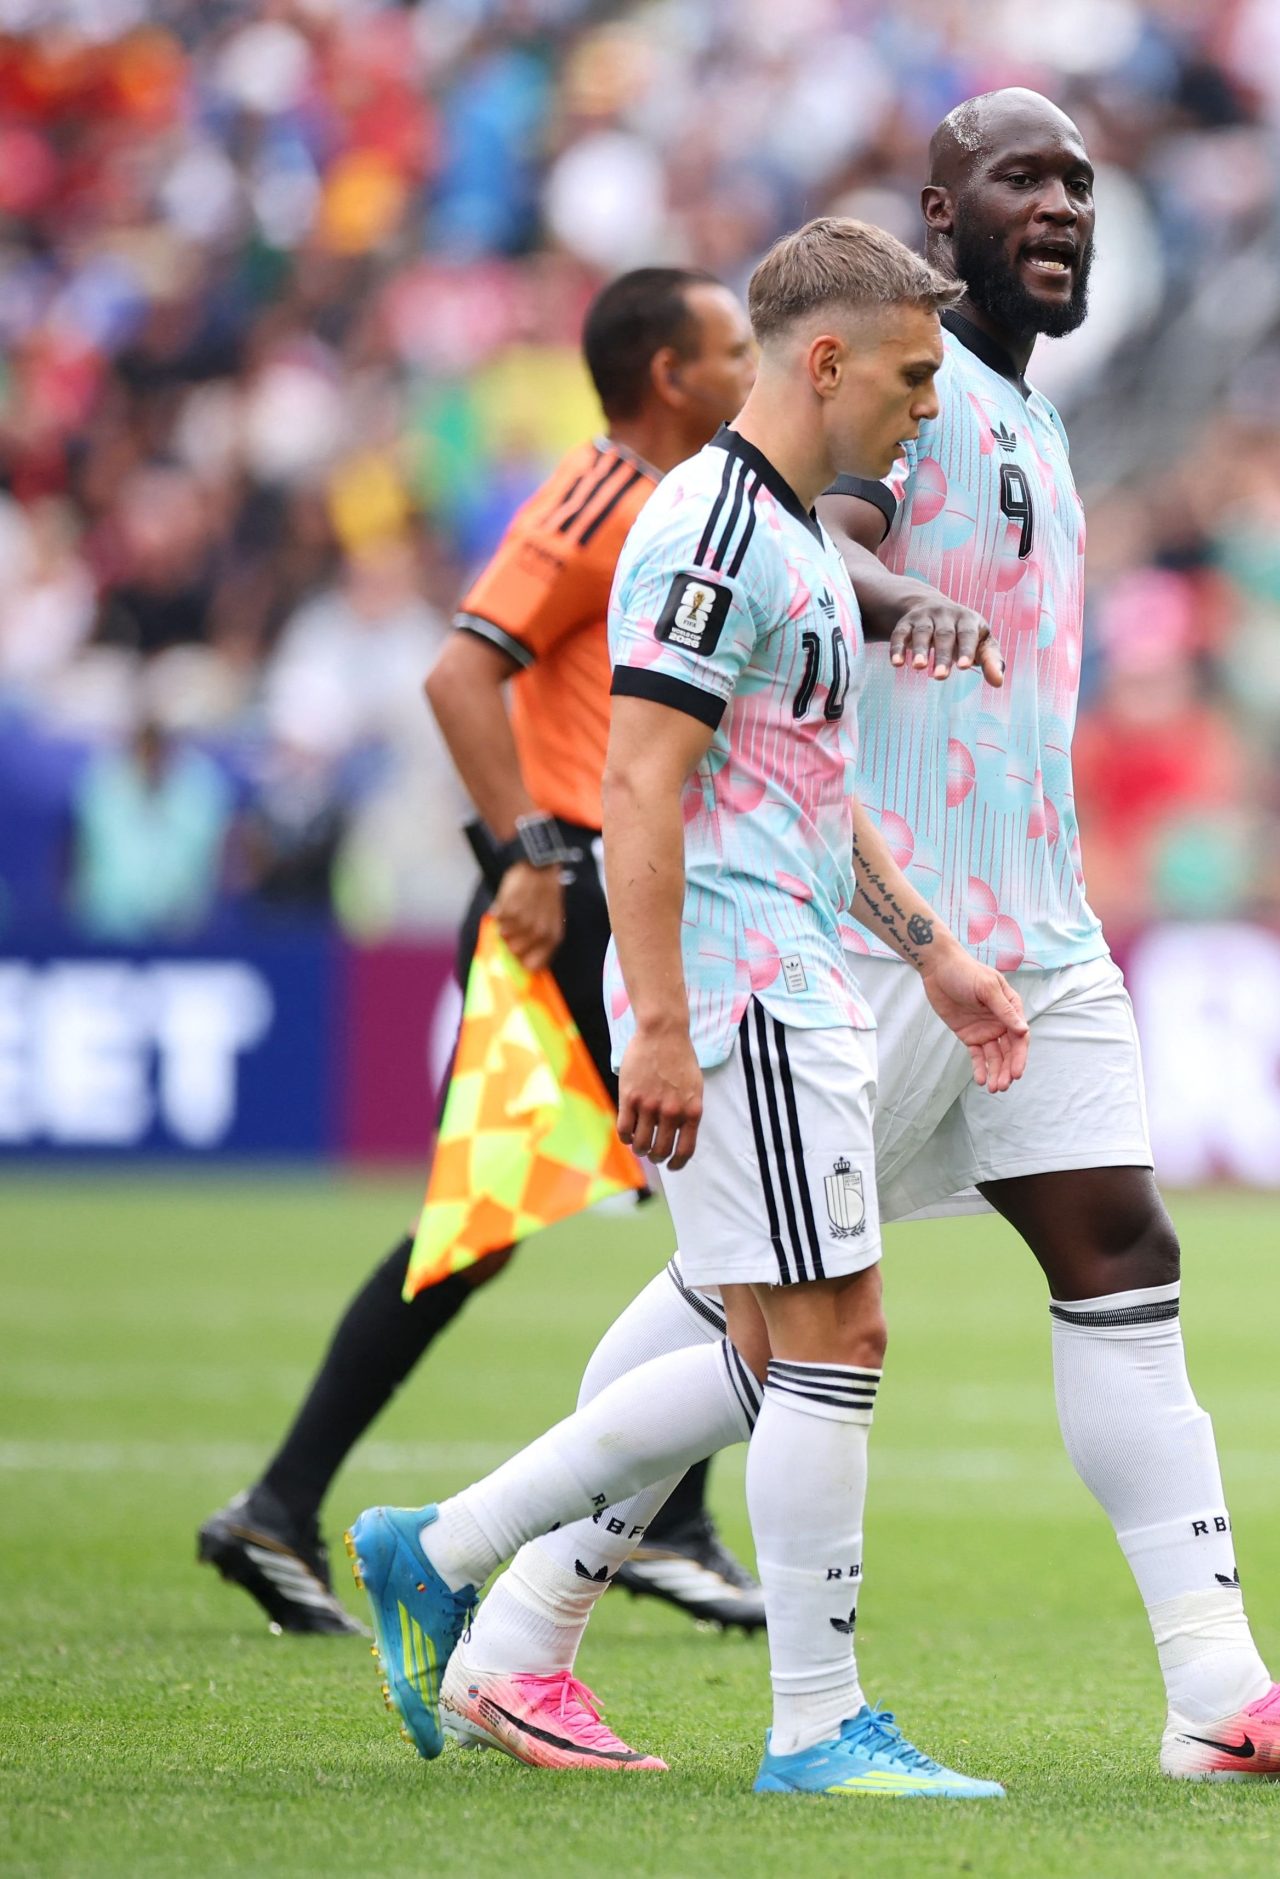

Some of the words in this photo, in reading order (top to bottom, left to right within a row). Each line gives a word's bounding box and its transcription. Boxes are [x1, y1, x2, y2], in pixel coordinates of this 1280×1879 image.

[999, 463, 1035, 561] 9
[668, 633, 700, 649] 2026
[792, 626, 850, 724] 10
